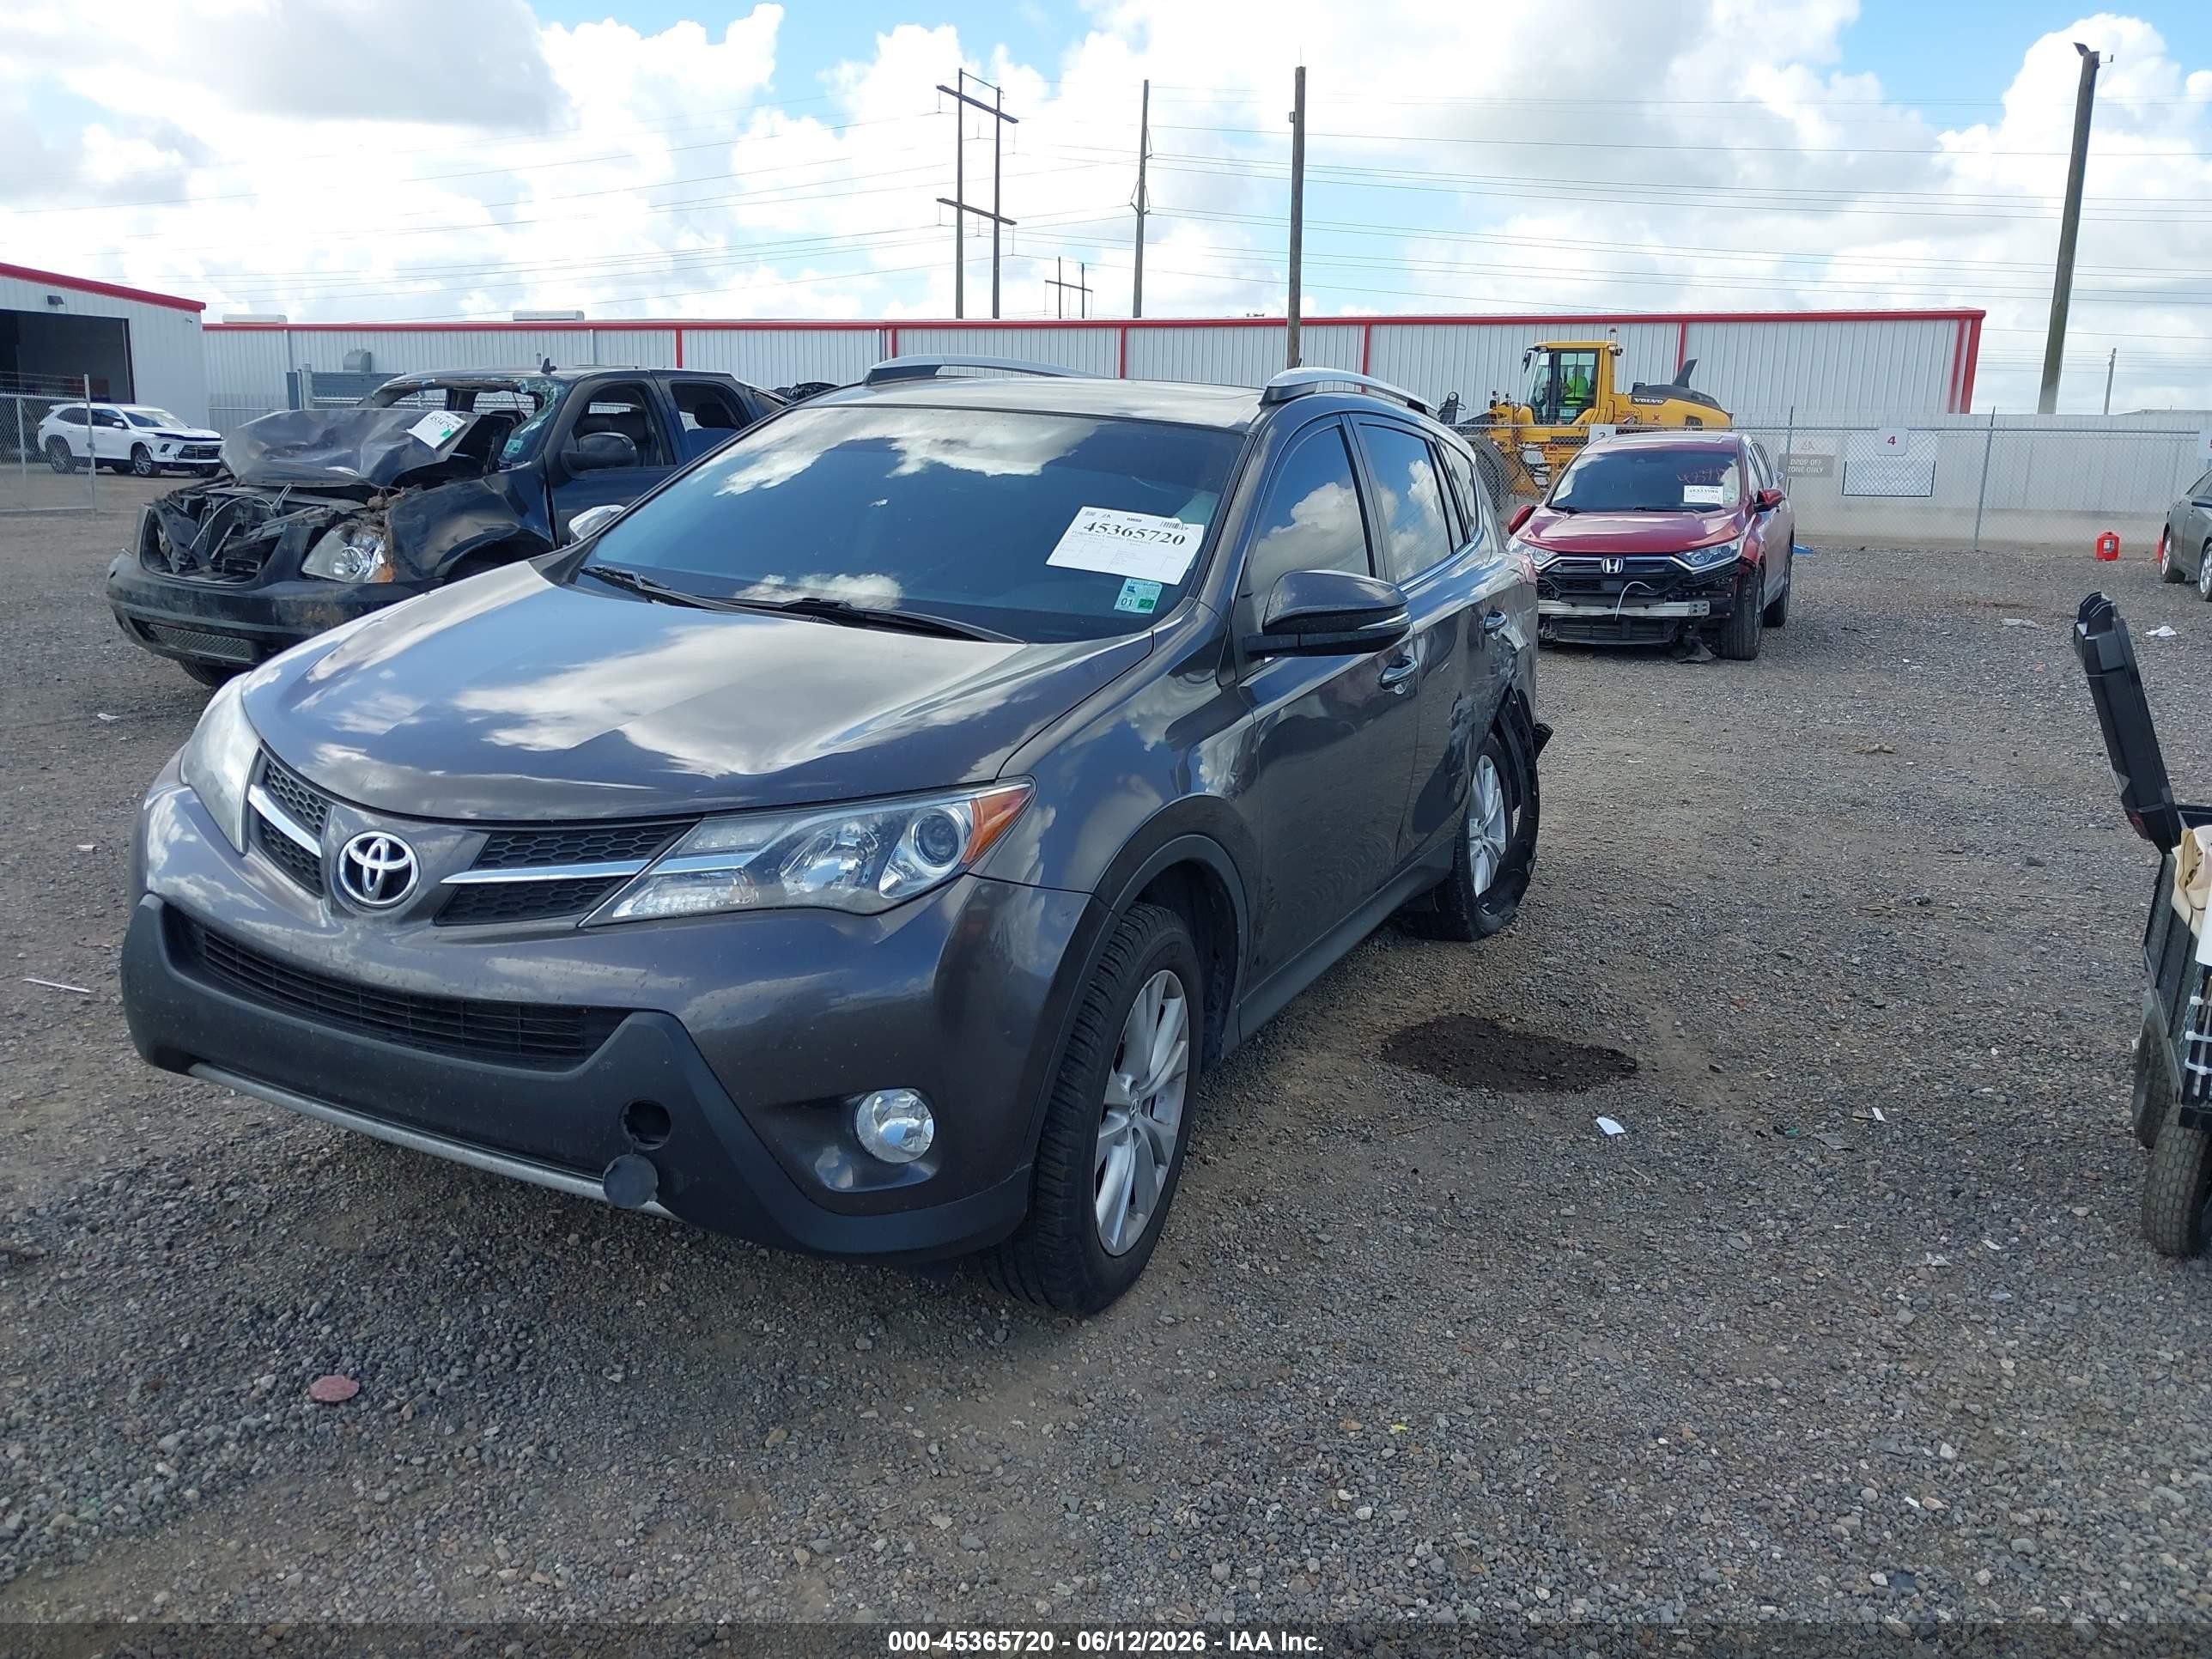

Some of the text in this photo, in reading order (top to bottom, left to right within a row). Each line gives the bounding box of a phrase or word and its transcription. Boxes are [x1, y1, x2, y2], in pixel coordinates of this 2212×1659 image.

[1887, 435, 1897, 446] 4
[1083, 520, 1186, 546] 45365720
[1120, 597, 1154, 609] 01 27
